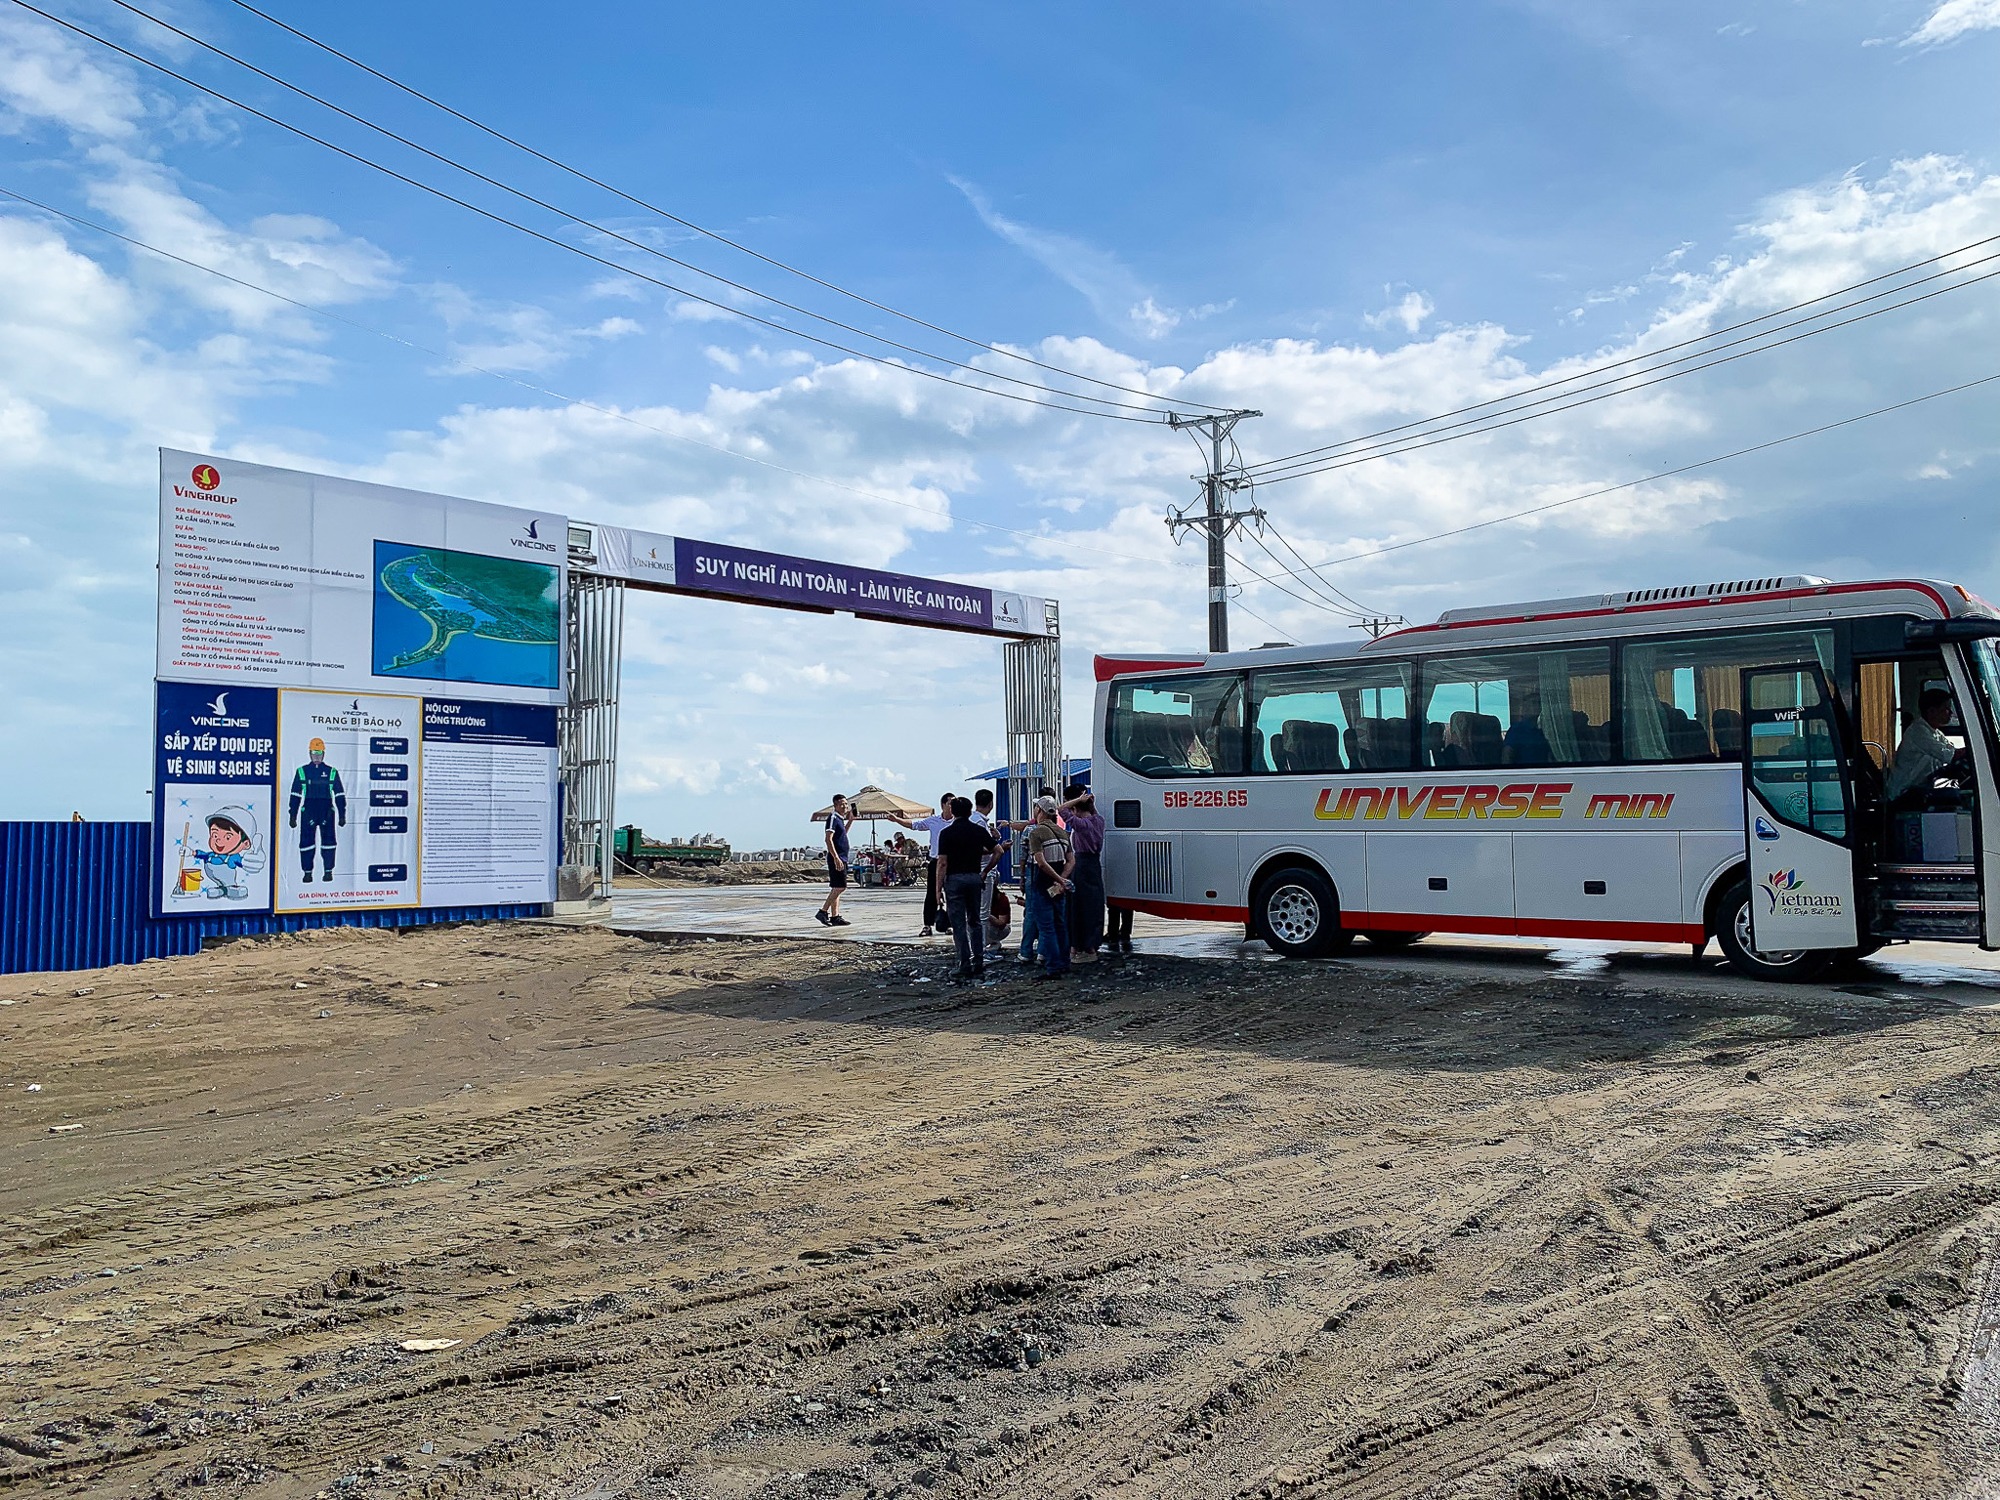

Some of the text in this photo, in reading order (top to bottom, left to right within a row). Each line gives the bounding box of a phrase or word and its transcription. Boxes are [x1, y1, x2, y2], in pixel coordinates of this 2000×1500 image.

[173, 484, 238, 505] VINGROUP
[510, 538, 556, 552] VINCONS
[632, 557, 674, 572] VINHOMES
[695, 556, 730, 578] SUY
[733, 562, 776, 584] NGHĨ
[779, 570, 802, 588] AN
[805, 573, 848, 595] TOÀN
[859, 579, 890, 601] LÀM
[892, 586, 923, 608] VIỆC
[926, 593, 945, 609] AN
[947, 595, 982, 614] TOÀN
[994, 614, 1019, 624] VINCONS
[425, 703, 461, 714] NỘI QUY
[1774, 711, 1800, 721] WiFi
[191, 716, 250, 728] VINCONS
[311, 715, 402, 729] TRANG BỊ BẢO HỘ
[425, 715, 486, 727] CÔNG TRƯỜNG
[164, 730, 274, 756] SẮP XẾP DỌN DẸP,
[167, 756, 271, 778] VỆ SINH SẠCH SẼ
[1163, 789, 1248, 809] 51B-226.65
[1314, 782, 1574, 820] UNIVERSE
[1757, 883, 1841, 915] Vietnam
